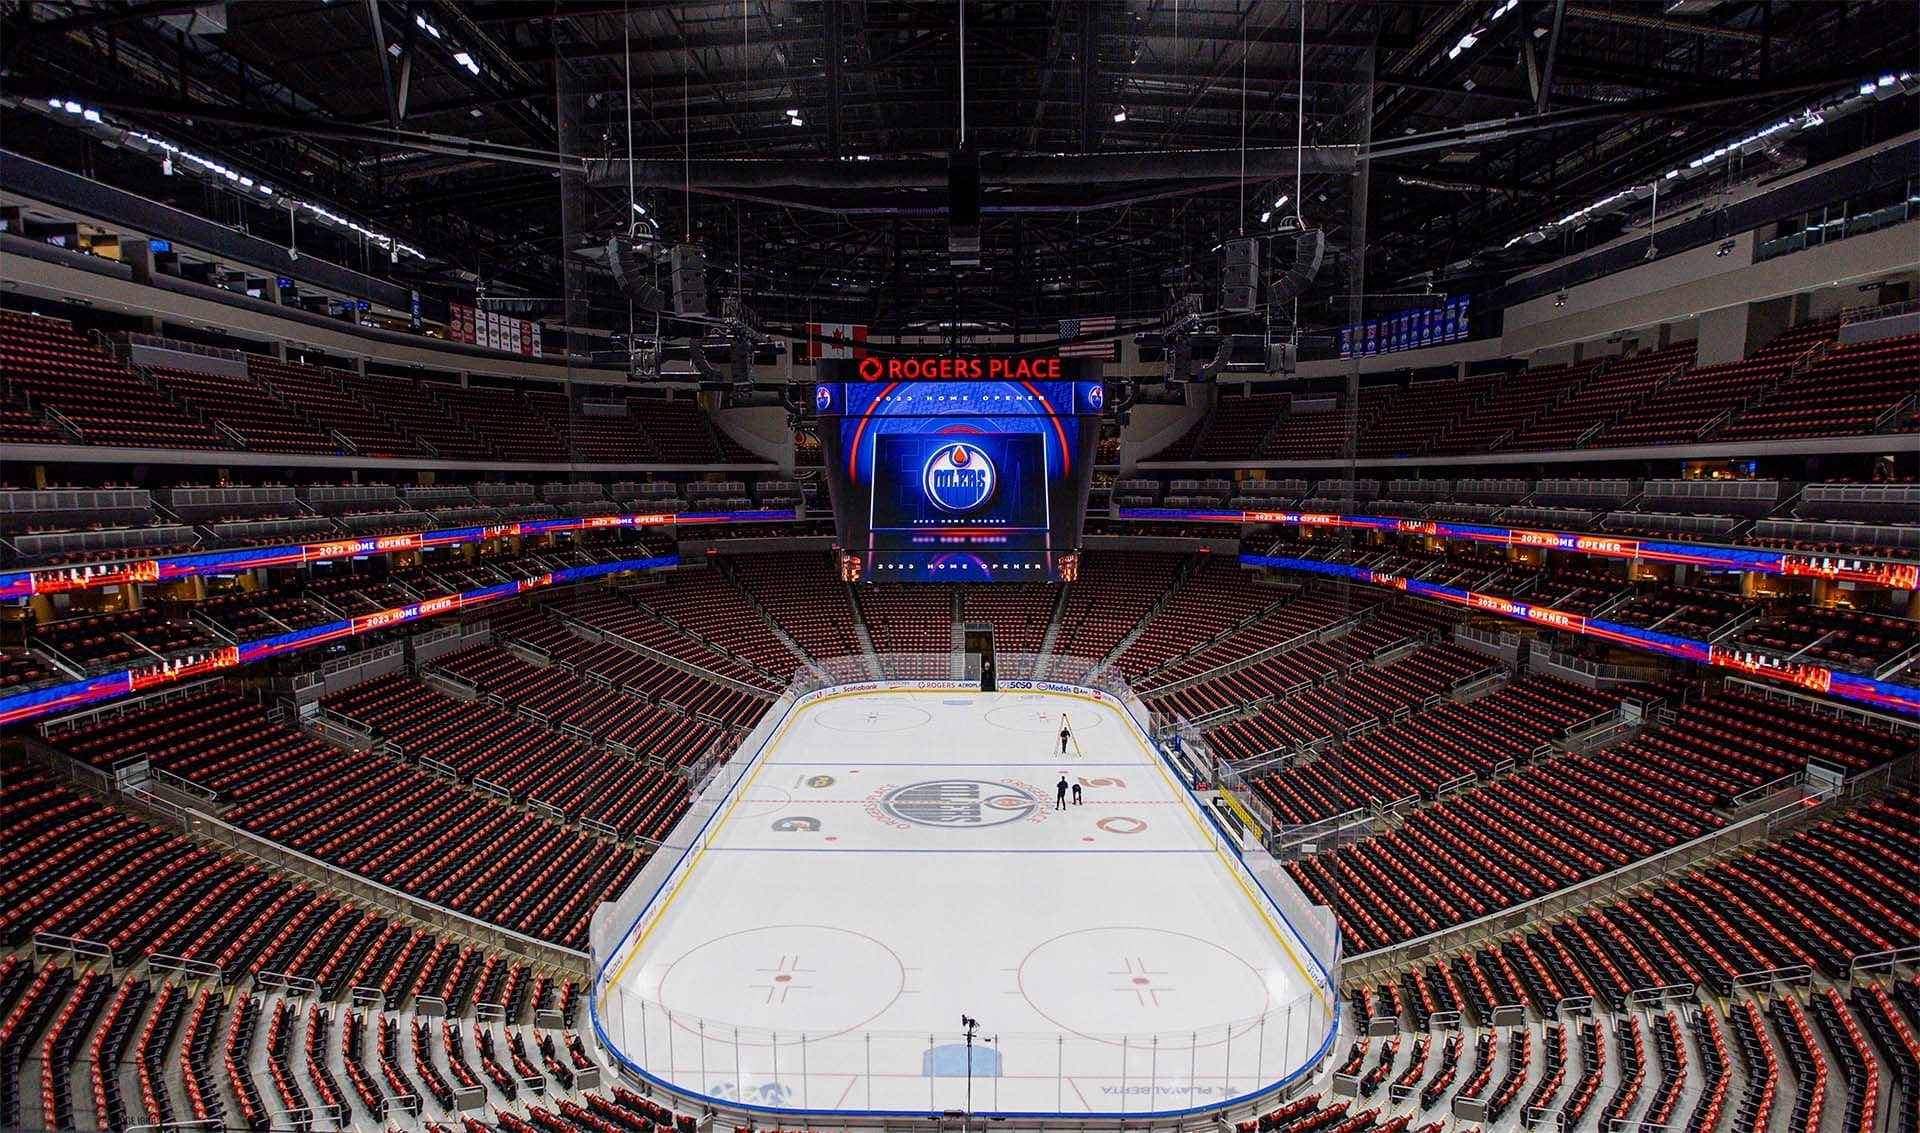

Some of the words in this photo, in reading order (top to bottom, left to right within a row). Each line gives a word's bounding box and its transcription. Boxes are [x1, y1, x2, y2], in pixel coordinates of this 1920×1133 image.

[888, 359, 982, 379] ROGERS
[989, 359, 1061, 378] PLACE
[933, 469, 986, 488] OILERS
[320, 546, 344, 556] 2023
[347, 542, 375, 552] HOME
[377, 538, 411, 549] OPENER
[1521, 534, 1543, 543] 2023
[1546, 536, 1575, 547] HOME
[1577, 540, 1621, 552] OPENER
[366, 614, 390, 627] 2023
[392, 607, 418, 620] HOME
[420, 599, 452, 613] OPENER
[1478, 598, 1498, 609] 2023
[1500, 603, 1527, 616] HOME
[1528, 609, 1569, 625] OPENER
[843, 683, 878, 693] Scotiabank
